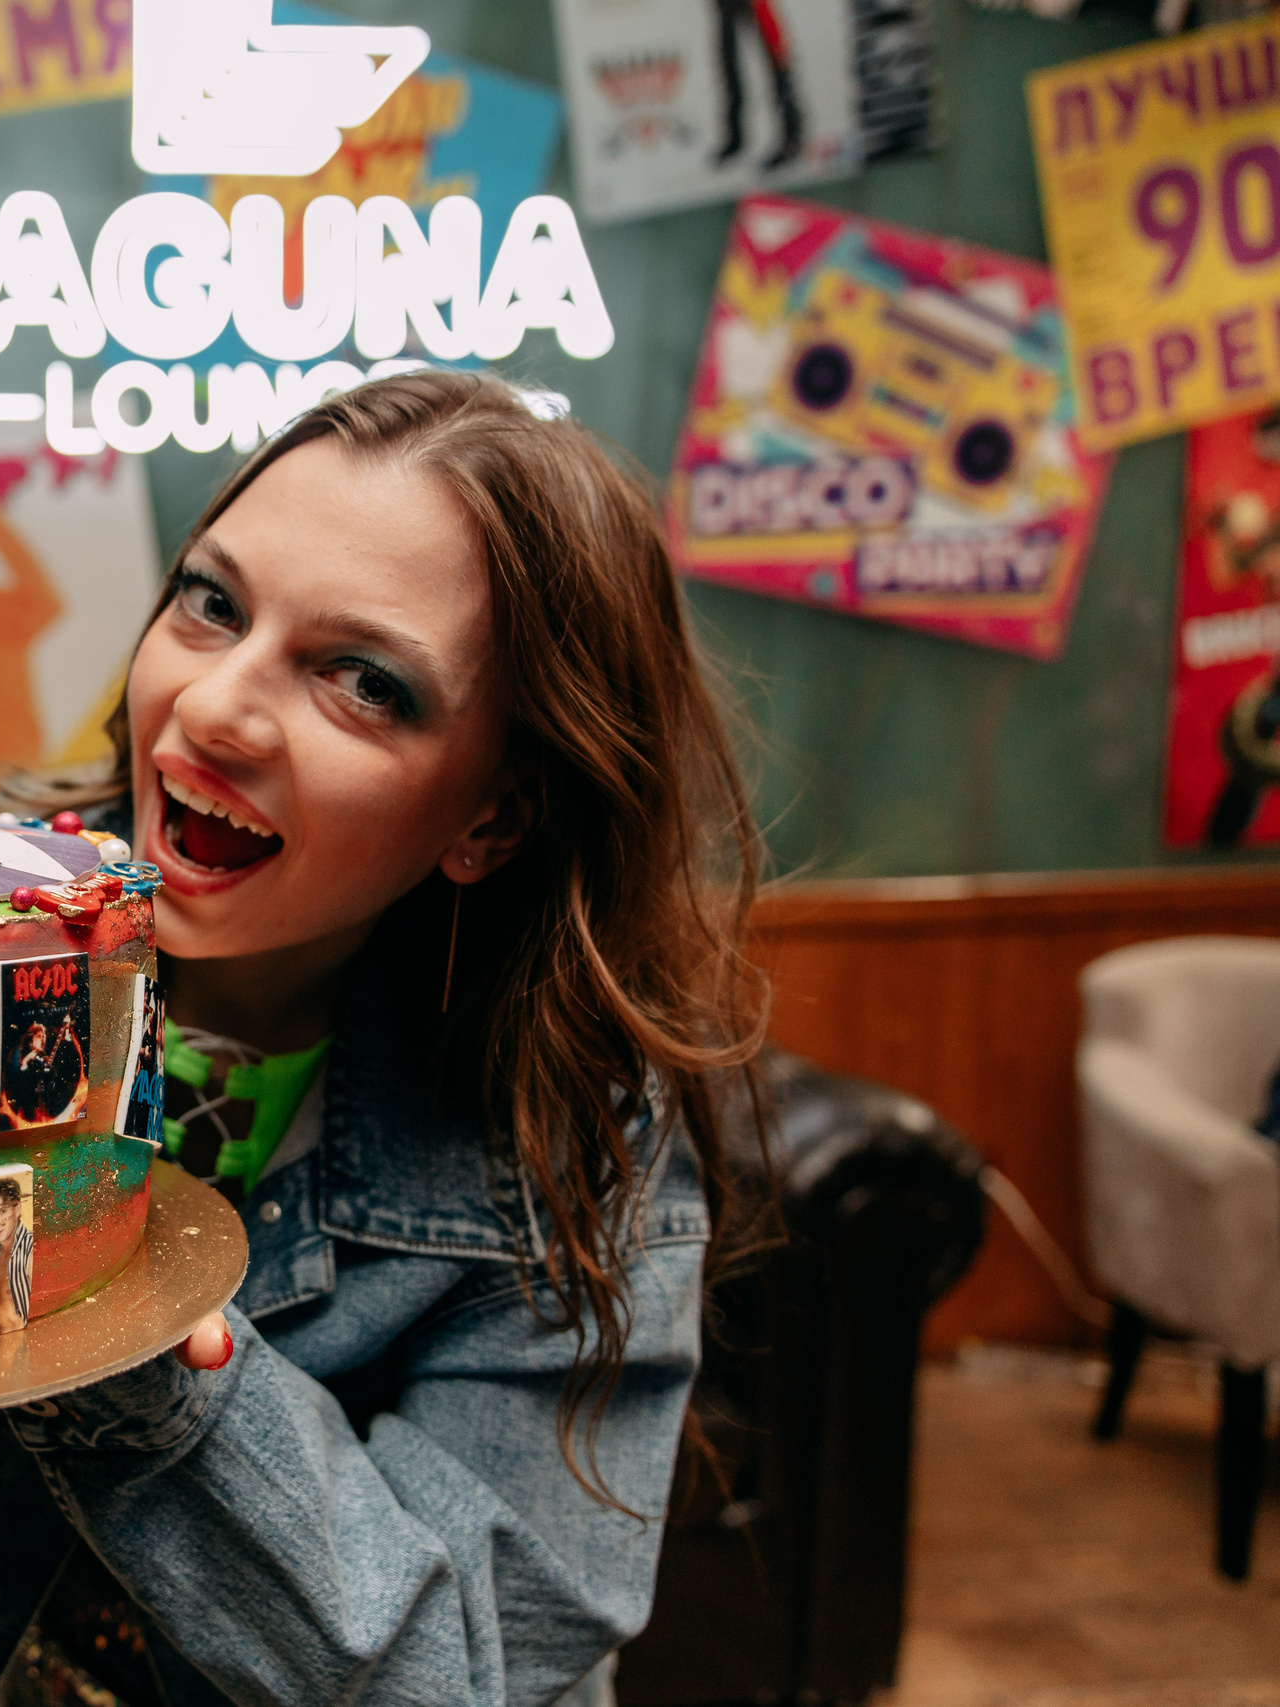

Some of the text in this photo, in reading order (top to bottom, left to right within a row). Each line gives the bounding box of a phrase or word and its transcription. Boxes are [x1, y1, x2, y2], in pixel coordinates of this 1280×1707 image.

[46, 359, 432, 456] LOUN
[1087, 302, 1280, 426] ВРЕ
[690, 455, 917, 534] DISCO
[857, 520, 1065, 592] PARTY
